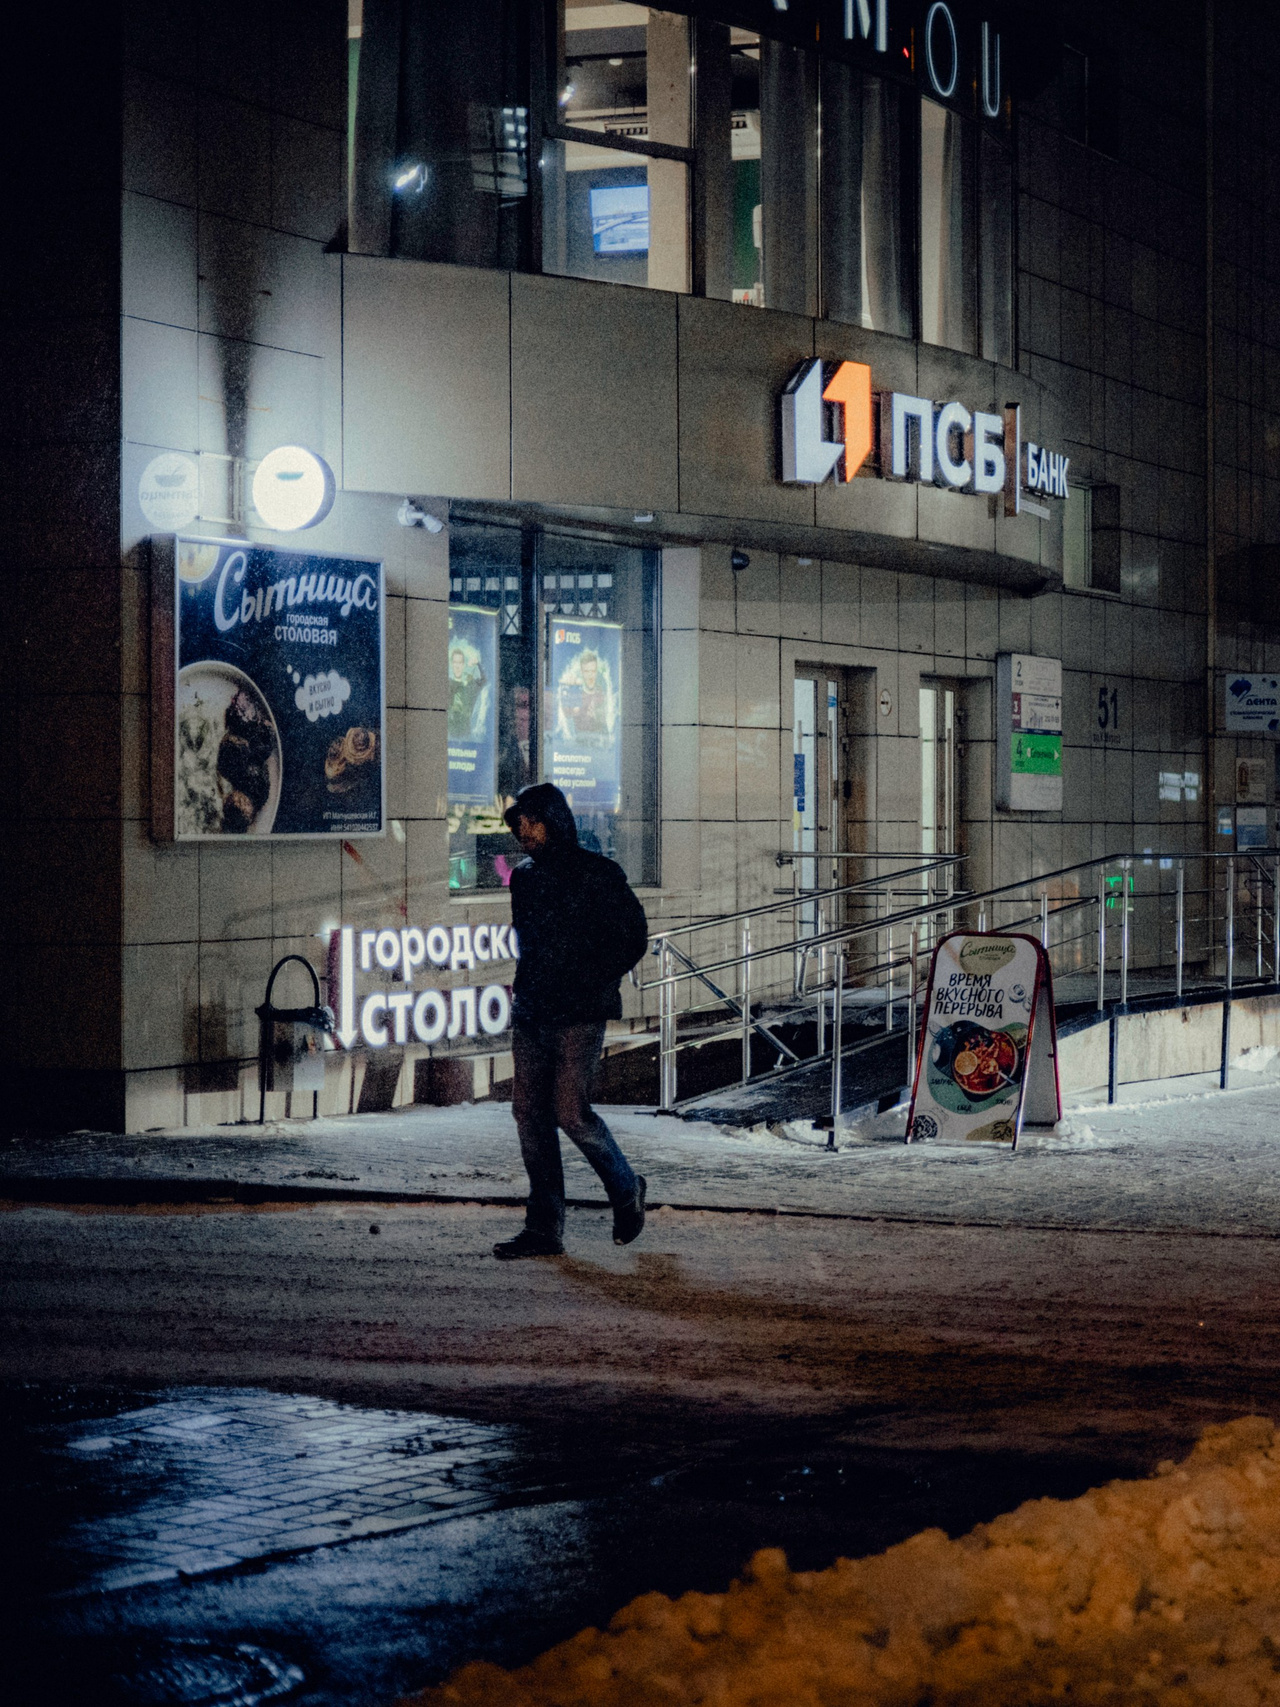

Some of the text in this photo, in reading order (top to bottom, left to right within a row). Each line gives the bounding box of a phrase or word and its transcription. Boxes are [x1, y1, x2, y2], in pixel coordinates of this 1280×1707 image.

[892, 392, 1070, 499] ПСБ БАНК
[214, 551, 377, 632] Сытница
[286, 613, 329, 627] городская
[274, 625, 338, 646] столовая
[309, 681, 332, 696] ВКУСНО
[1097, 687, 1119, 730] 51
[948, 973, 992, 989] ВРЕМЯ
[936, 987, 1005, 1004] ВКУСНОГО
[933, 1001, 1003, 1019] ПЕРЕРЫВА
